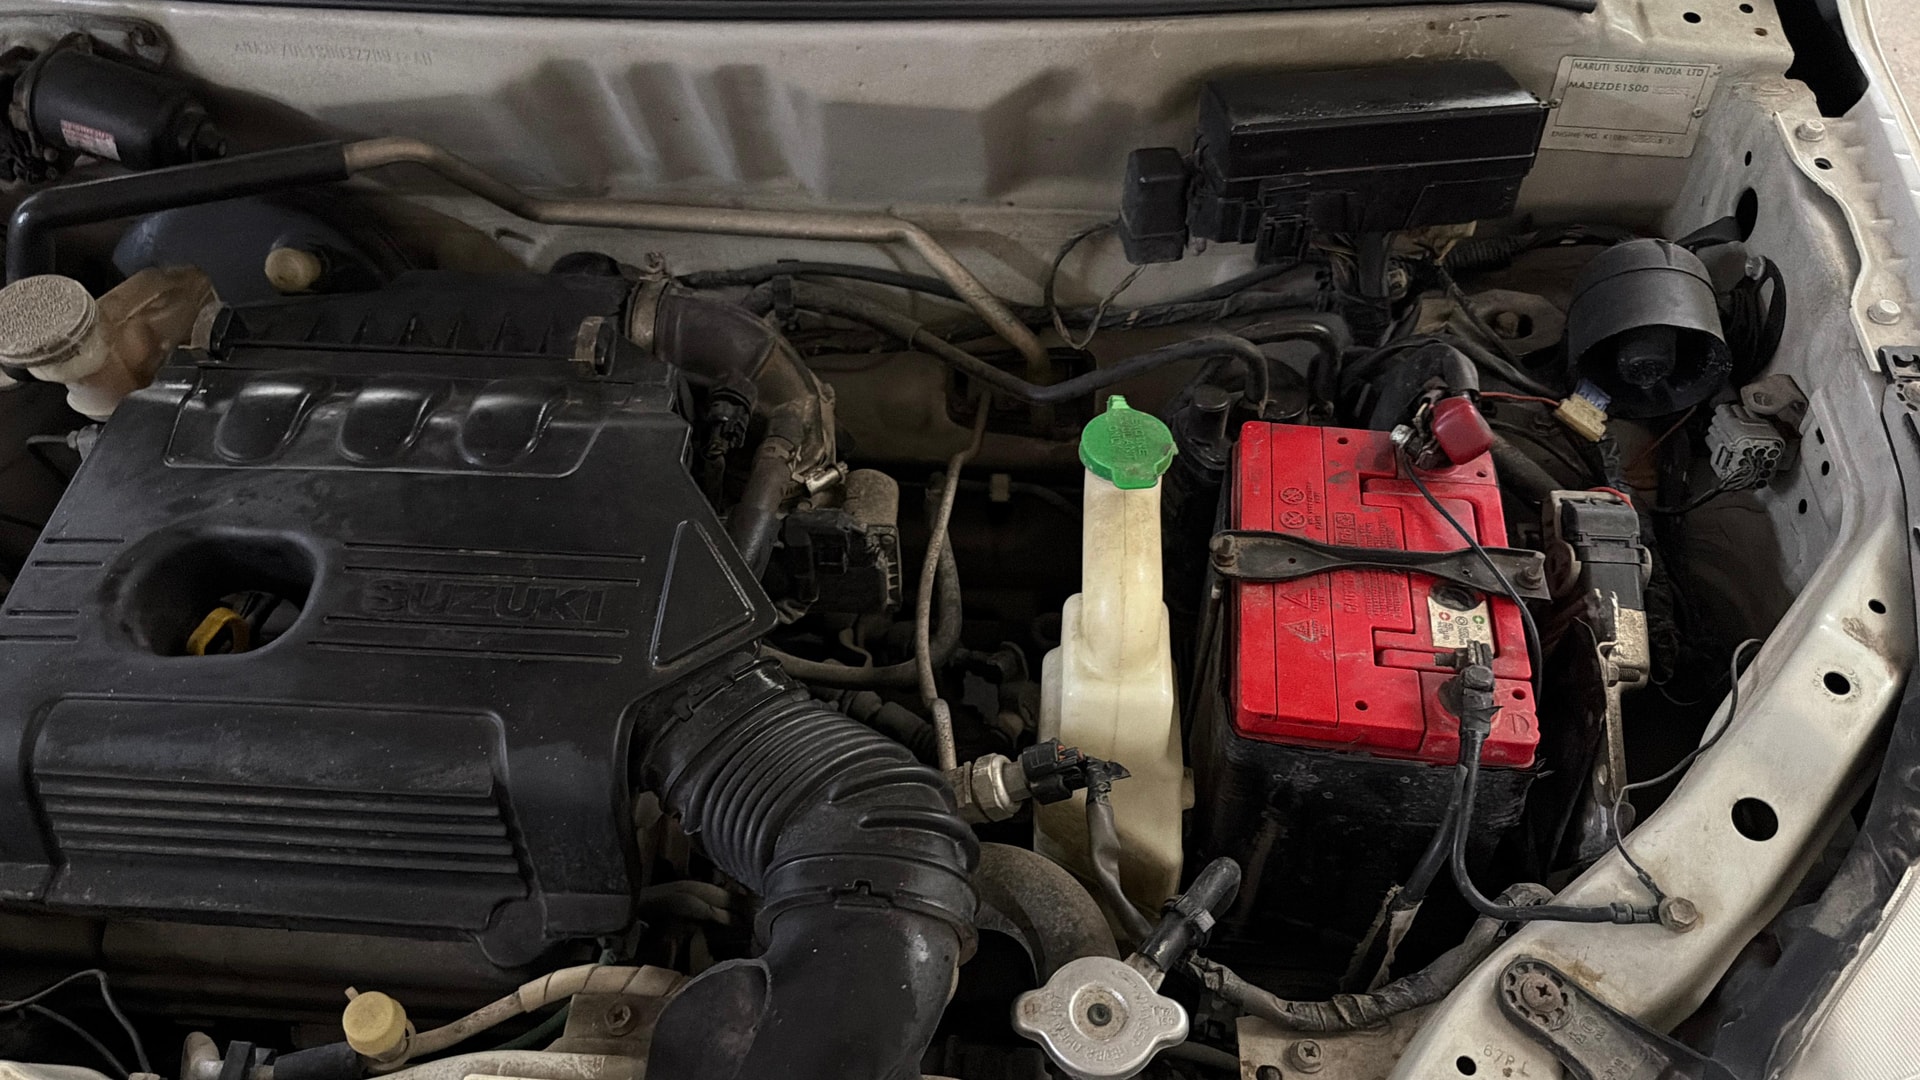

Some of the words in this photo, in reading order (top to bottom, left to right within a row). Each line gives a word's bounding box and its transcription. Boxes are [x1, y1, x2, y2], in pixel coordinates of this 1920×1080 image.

[1573, 61, 1609, 71] MARUTI
[1614, 64, 1650, 74] SUZUKI
[1654, 66, 1682, 76] INDIA
[1687, 68, 1705, 77] LTD
[1551, 130, 1581, 139] ENGINE
[363, 578, 606, 622] SUZUKI
